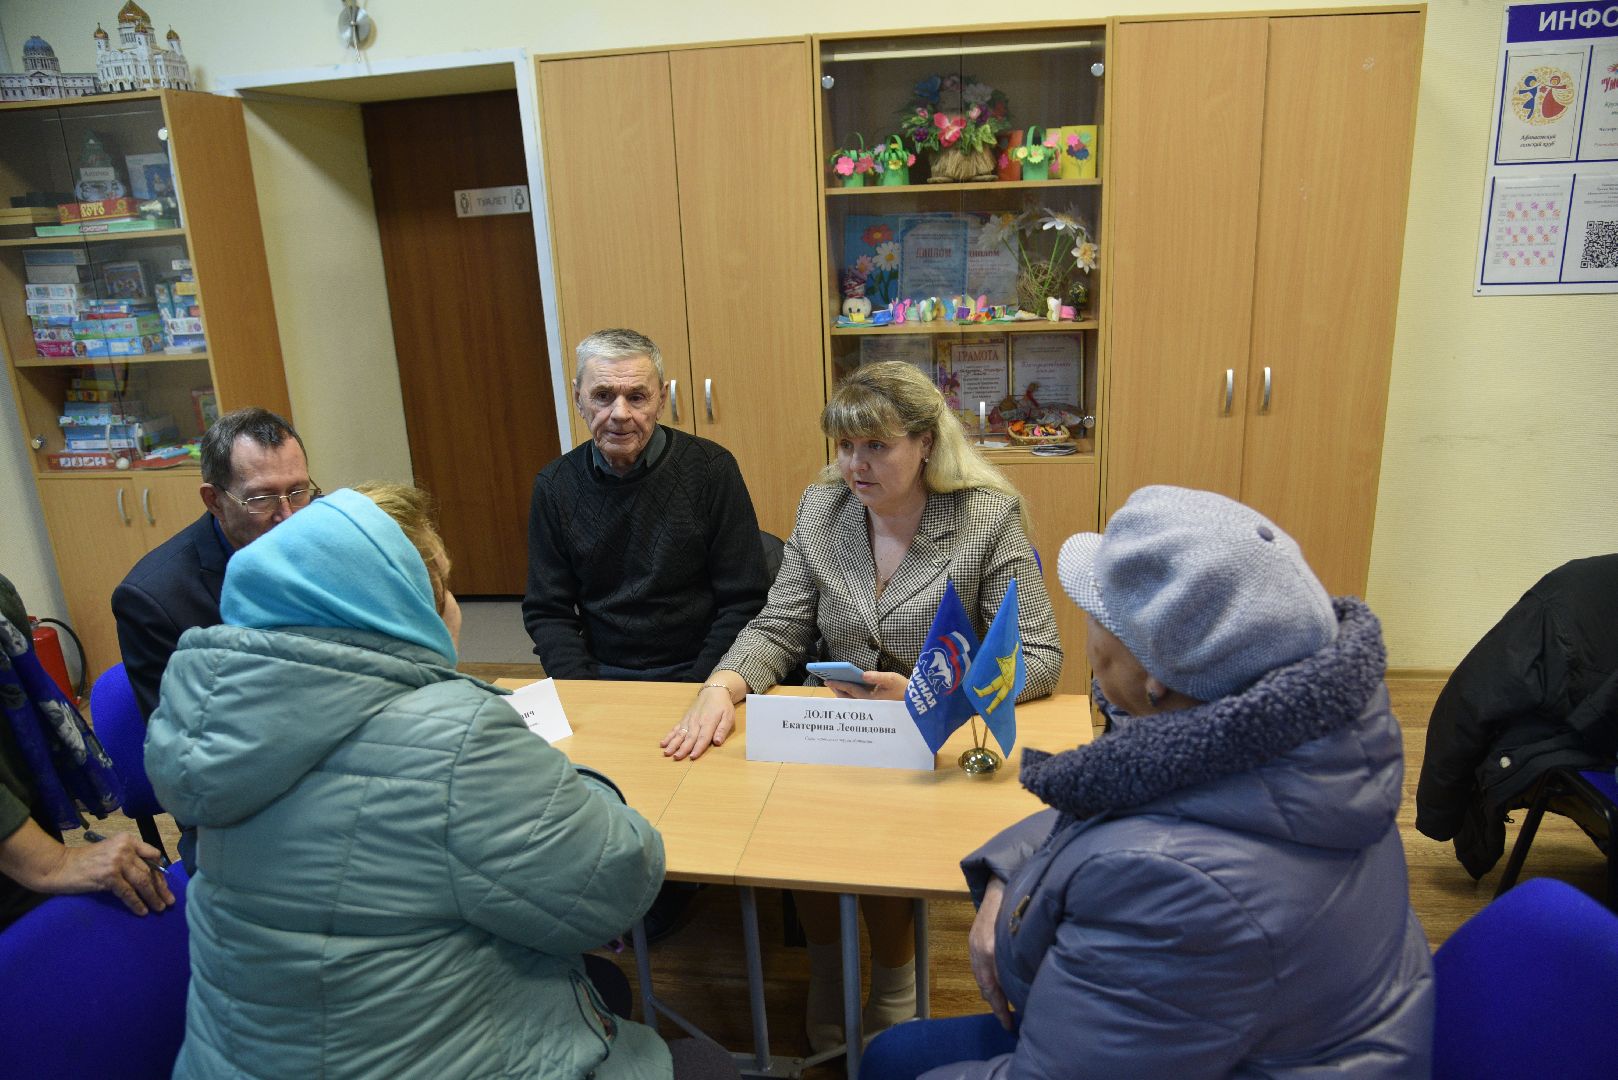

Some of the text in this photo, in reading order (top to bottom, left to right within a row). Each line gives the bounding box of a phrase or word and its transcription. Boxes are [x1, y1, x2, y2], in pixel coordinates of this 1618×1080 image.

[1538, 6, 1618, 32] ИНФО
[958, 350, 999, 361] ГРАМОТА
[907, 674, 928, 715] ССИЯ
[913, 663, 938, 708] ДИНАЯ
[803, 709, 874, 721] ДОЛГАСОВА
[782, 720, 897, 734] Екатерина Леонидовна
